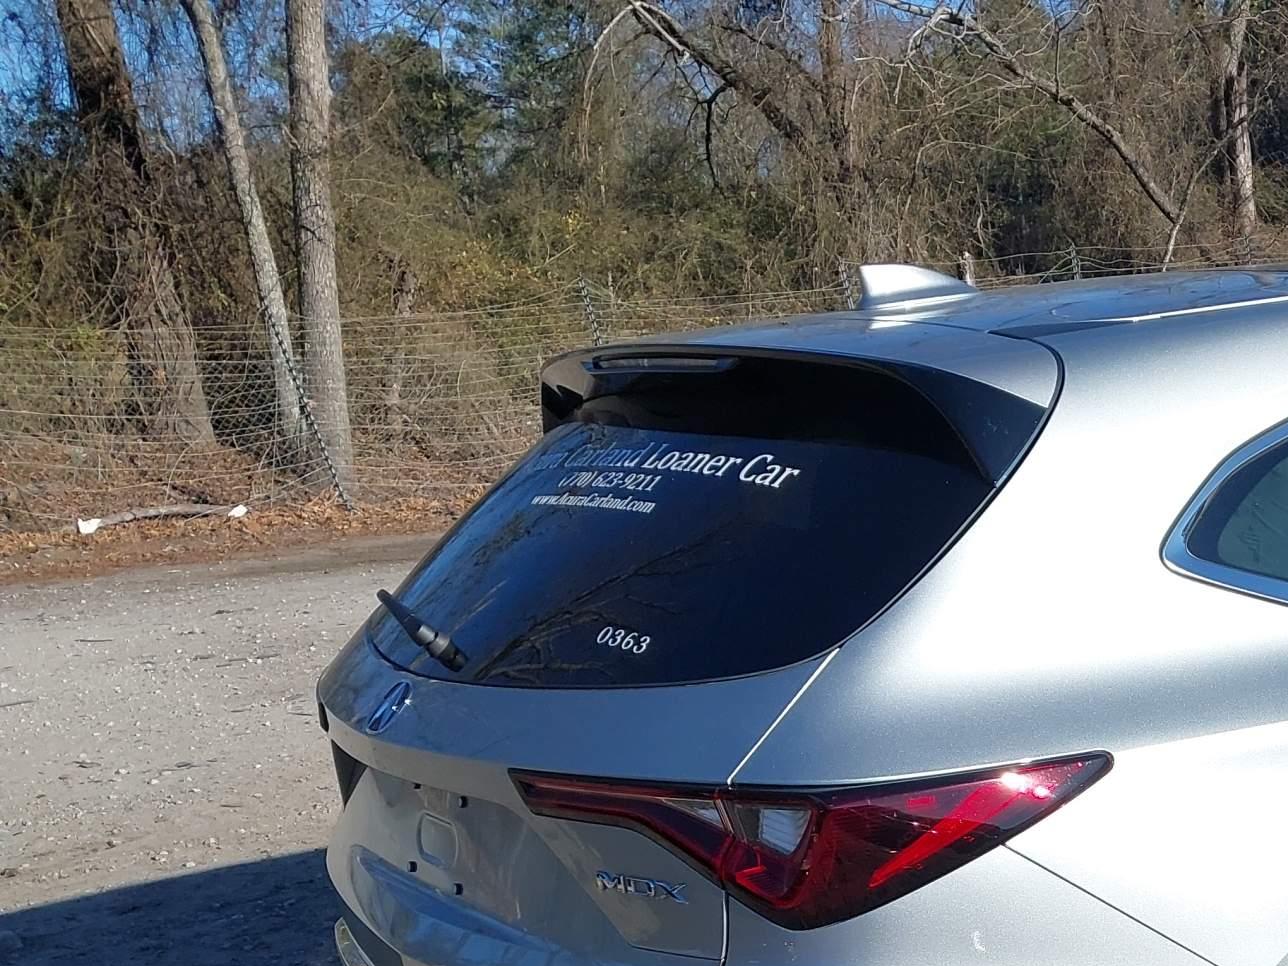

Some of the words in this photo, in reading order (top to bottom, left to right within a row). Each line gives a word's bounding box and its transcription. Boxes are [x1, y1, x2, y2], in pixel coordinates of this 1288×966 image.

[564, 441, 655, 468] Carland
[641, 443, 743, 477] Loaner
[739, 454, 801, 488] Car
[591, 472, 661, 491] 623-9211
[596, 626, 650, 653] 0363
[595, 870, 689, 905] MDX
